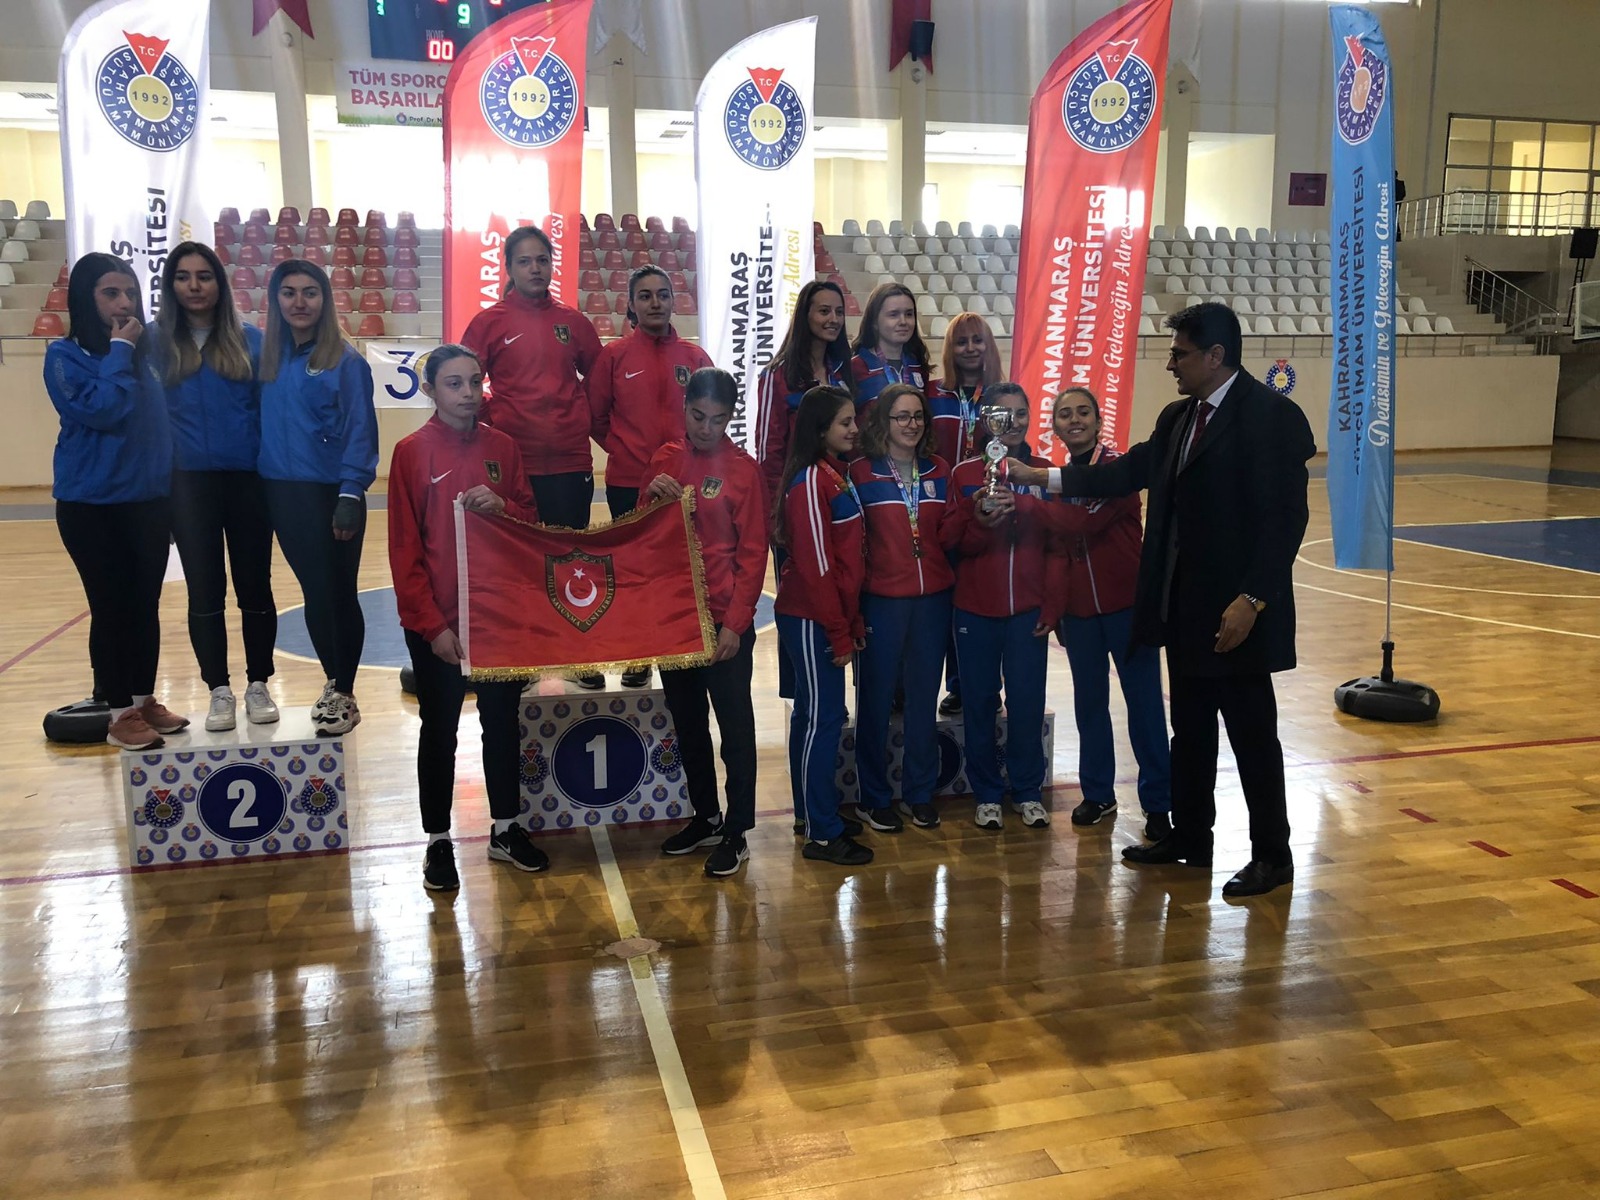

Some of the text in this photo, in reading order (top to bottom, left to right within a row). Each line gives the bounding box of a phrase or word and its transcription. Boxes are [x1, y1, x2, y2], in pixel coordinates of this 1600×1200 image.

[457, 3, 471, 24] 9
[428, 40, 454, 60] 00
[349, 68, 386, 86] TÜM
[132, 91, 169, 105] 1992
[513, 92, 546, 103] 1992
[1094, 97, 1125, 107] 1992
[753, 119, 782, 129] 1992
[1374, 182, 1389, 241] Adresi
[752, 203, 774, 366] ÜNİVERSİTE
[1373, 244, 1392, 328] Geleceğin
[1103, 280, 1132, 369] Geleceğin
[1337, 222, 1351, 432] KAHRAMANMARAŞ
[1377, 332, 1390, 351] ve
[730, 251, 753, 451] AHRAMANMARAŞ
[1353, 333, 1365, 395] İMAM
[1105, 372, 1120, 393] ve
[585, 734, 608, 790] 1
[227, 779, 259, 829] 2
